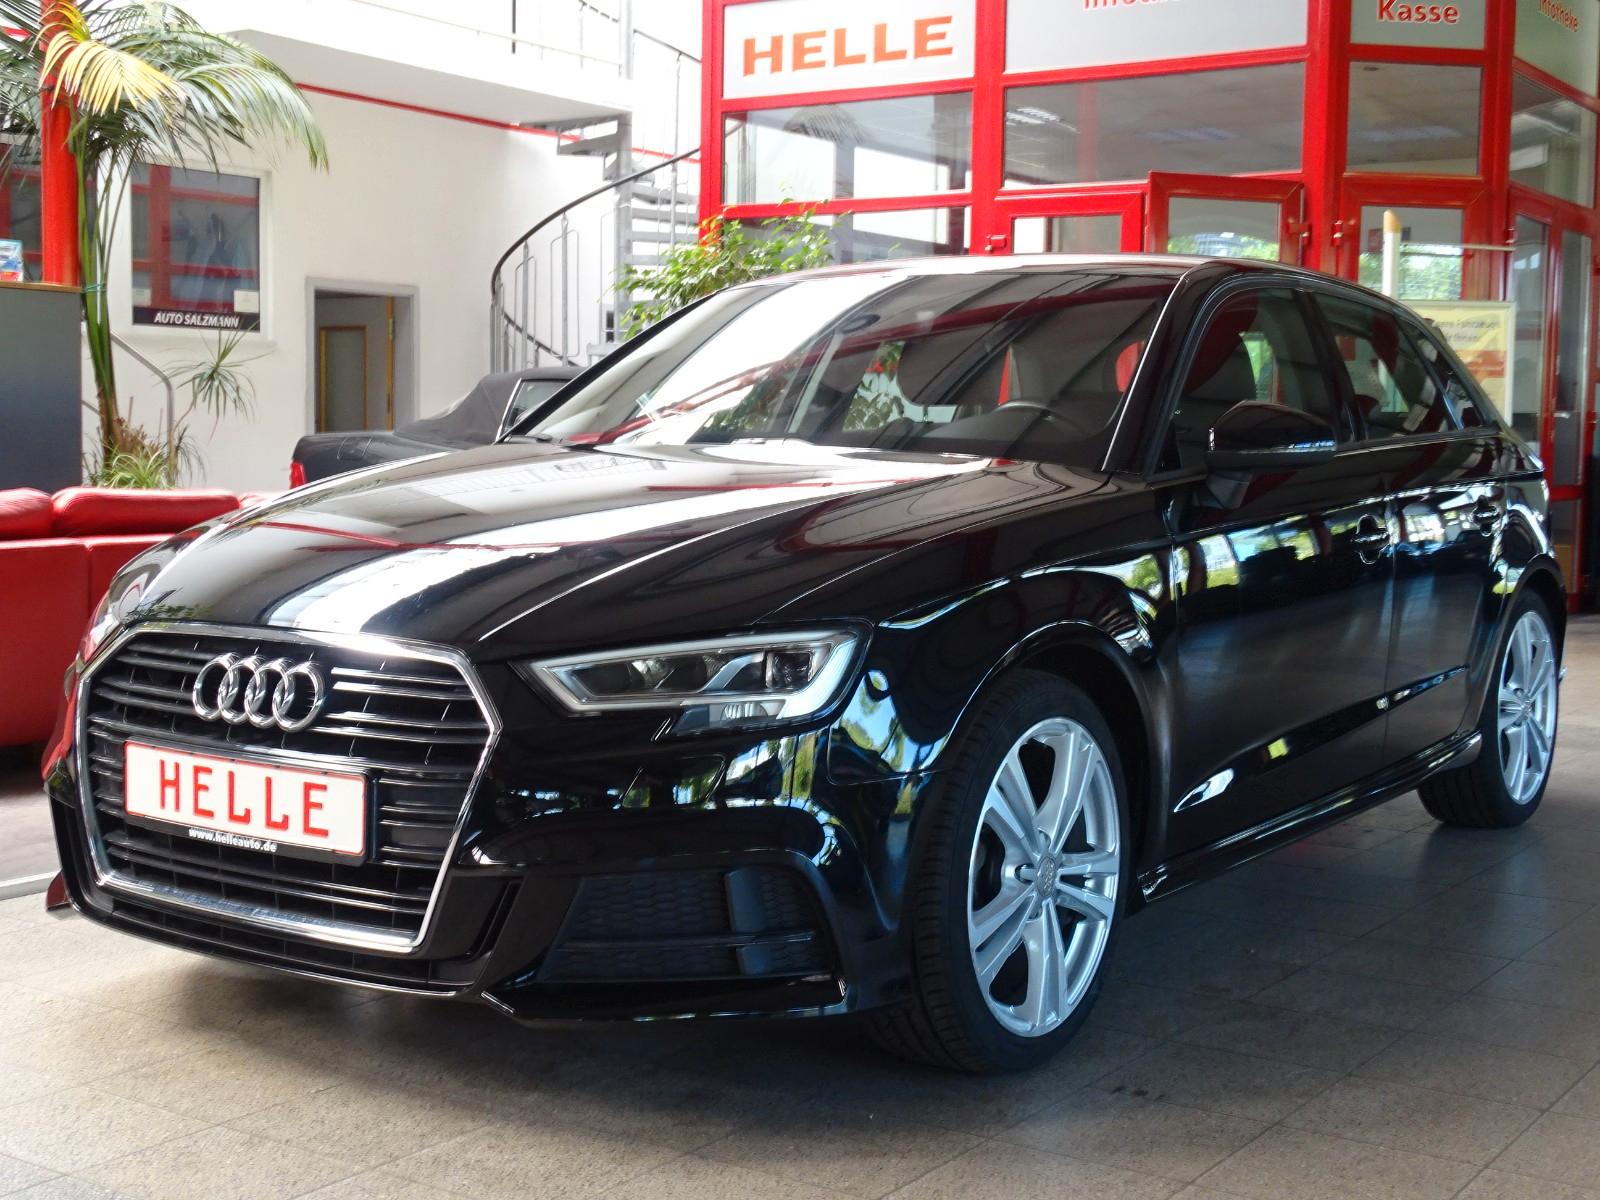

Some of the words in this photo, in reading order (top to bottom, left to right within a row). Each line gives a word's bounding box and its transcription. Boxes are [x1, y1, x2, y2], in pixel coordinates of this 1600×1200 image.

[1378, 0, 1459, 24] Kasse
[744, 15, 953, 77] HELLE
[154, 311, 183, 324] AUTO
[184, 313, 239, 328] SALZMANN
[160, 759, 329, 838] HELLE
[188, 827, 278, 852] www.helleauto.de
